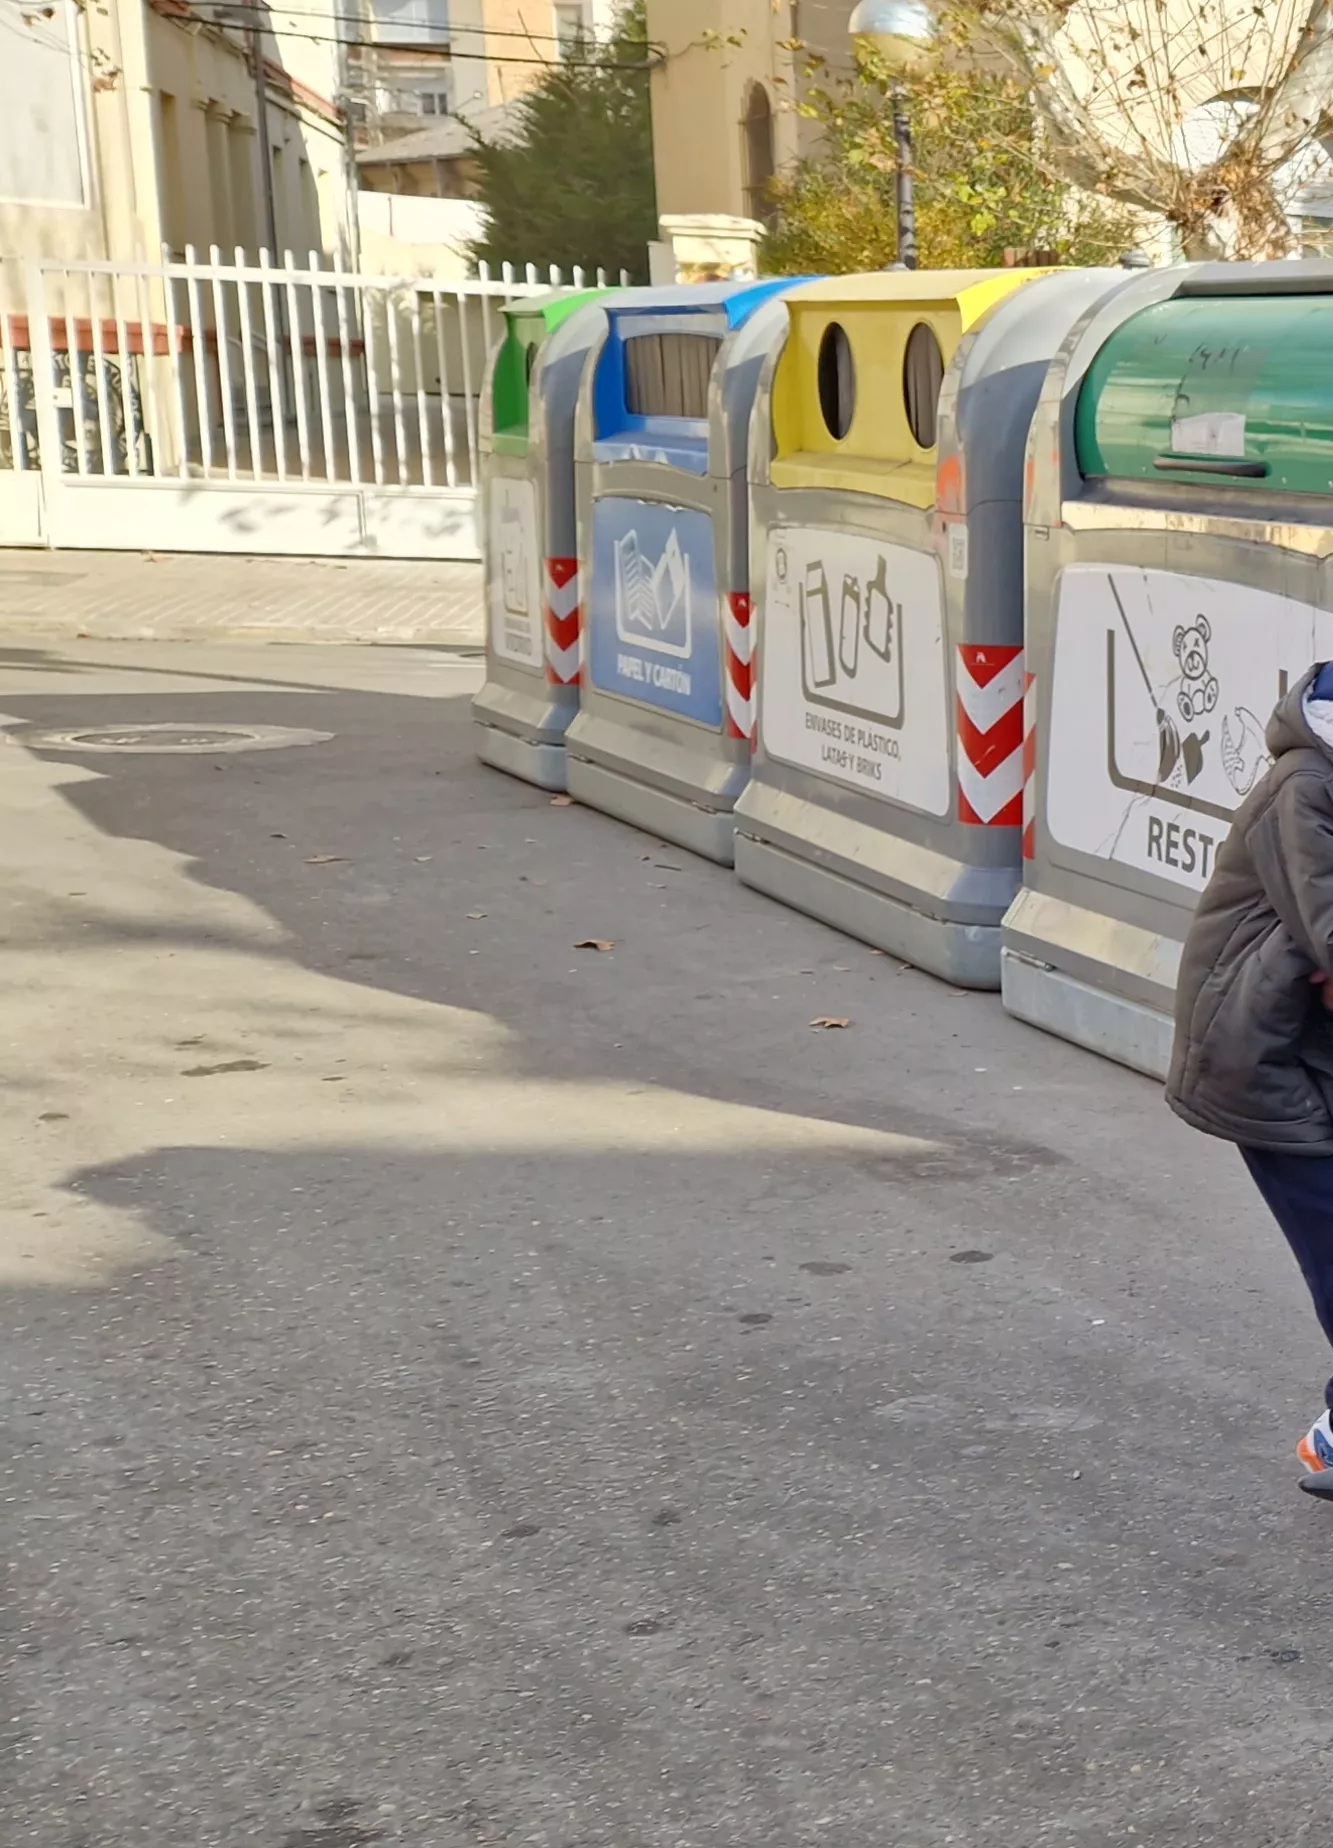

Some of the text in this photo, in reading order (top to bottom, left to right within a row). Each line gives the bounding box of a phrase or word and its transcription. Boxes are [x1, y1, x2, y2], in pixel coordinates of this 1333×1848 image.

[617, 653, 644, 681] PAPEL
[644, 661, 653, 684] Y
[805, 711, 842, 740] ENVASES
[843, 724, 856, 744] DE
[821, 744, 847, 768] LATAS
[857, 755, 882, 780] BRIKS
[1147, 815, 1223, 878] REST
